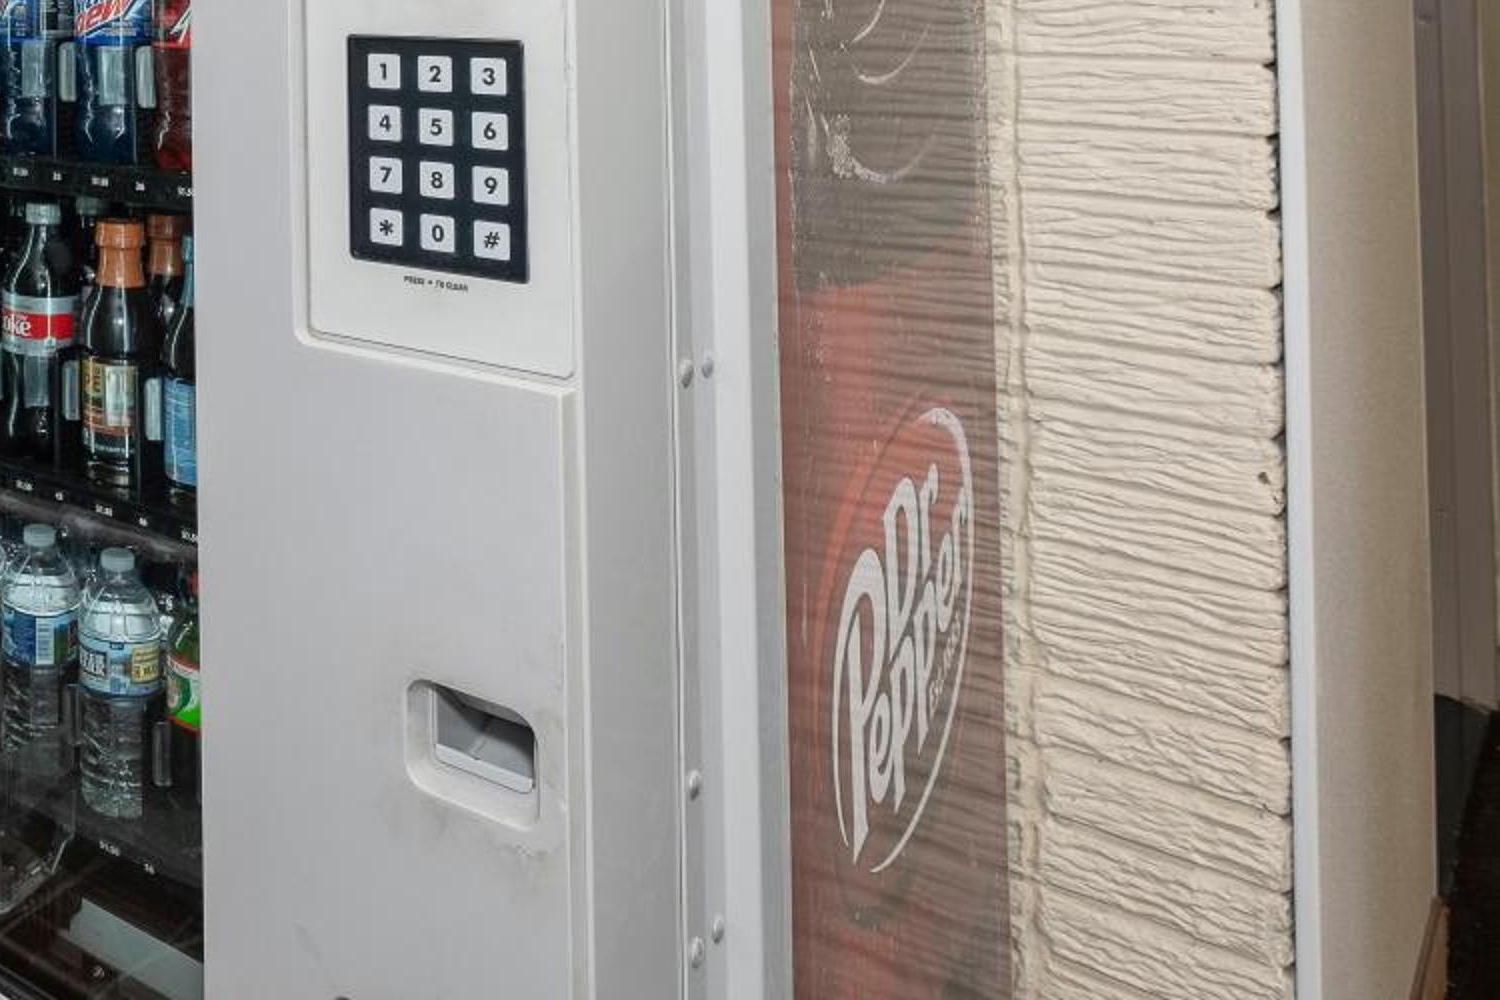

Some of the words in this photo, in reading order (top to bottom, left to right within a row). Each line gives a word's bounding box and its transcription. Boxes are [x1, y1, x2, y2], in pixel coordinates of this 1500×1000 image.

[378, 62, 388, 81] 1
[429, 65, 442, 83] 2
[482, 67, 496, 87] 3
[379, 114, 392, 132] 4
[429, 118, 443, 136] 5
[483, 121, 497, 141] 6
[379, 166, 393, 184] 7
[430, 171, 444, 189] 8
[484, 176, 498, 195] 9
[431, 224, 445, 243] 0
[483, 231, 501, 249] #
[883, 462, 940, 664] Dr
[833, 486, 970, 866] Pepper
